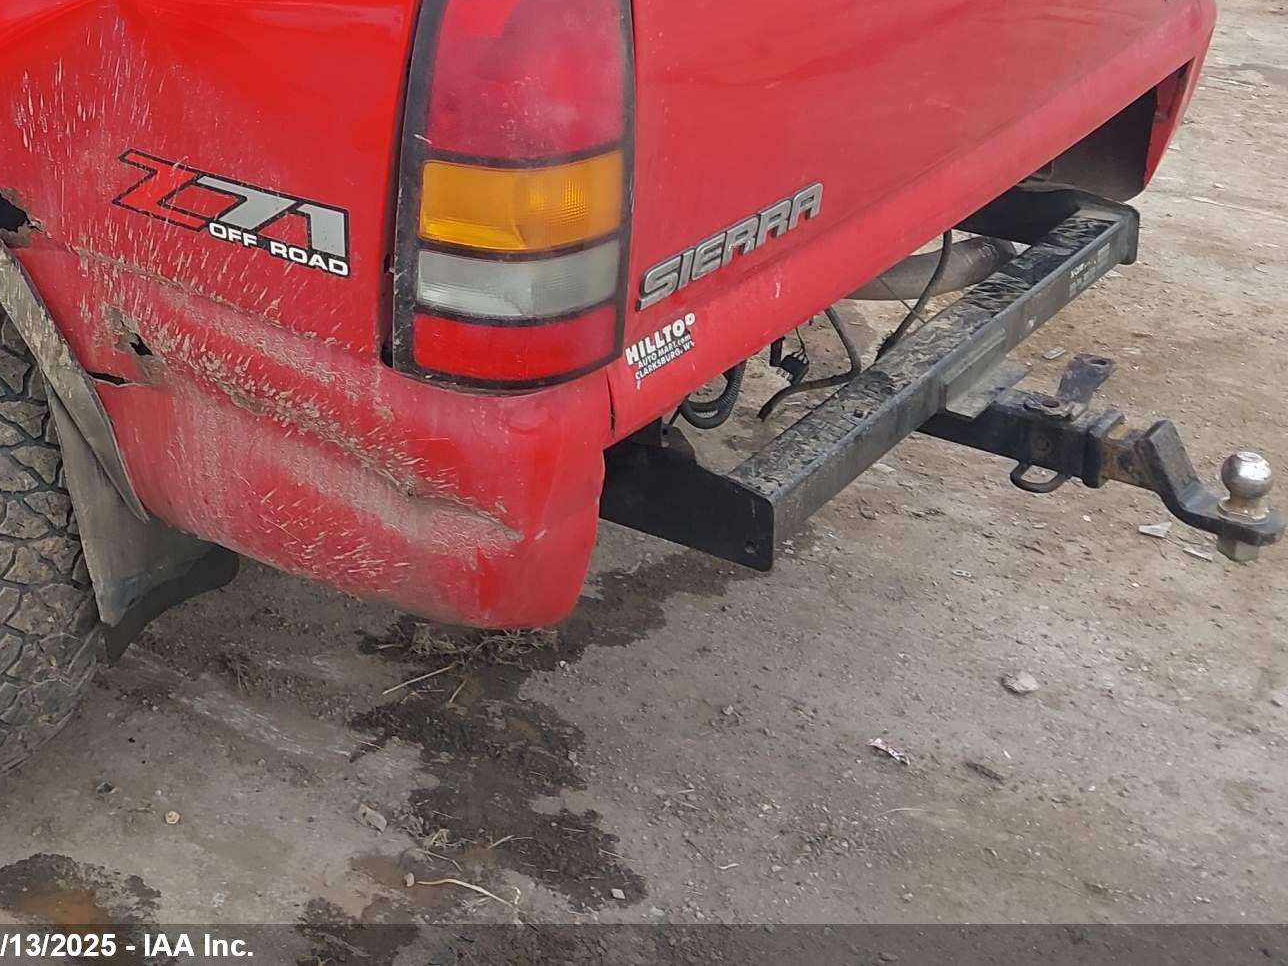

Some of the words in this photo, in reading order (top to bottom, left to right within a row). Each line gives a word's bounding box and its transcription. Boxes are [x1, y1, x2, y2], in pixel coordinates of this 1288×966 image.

[112, 148, 350, 258] Z71
[208, 222, 258, 248] OFF
[269, 240, 350, 277] ROAD
[636, 182, 823, 311] SIERRA
[638, 352, 658, 369] AUTO
